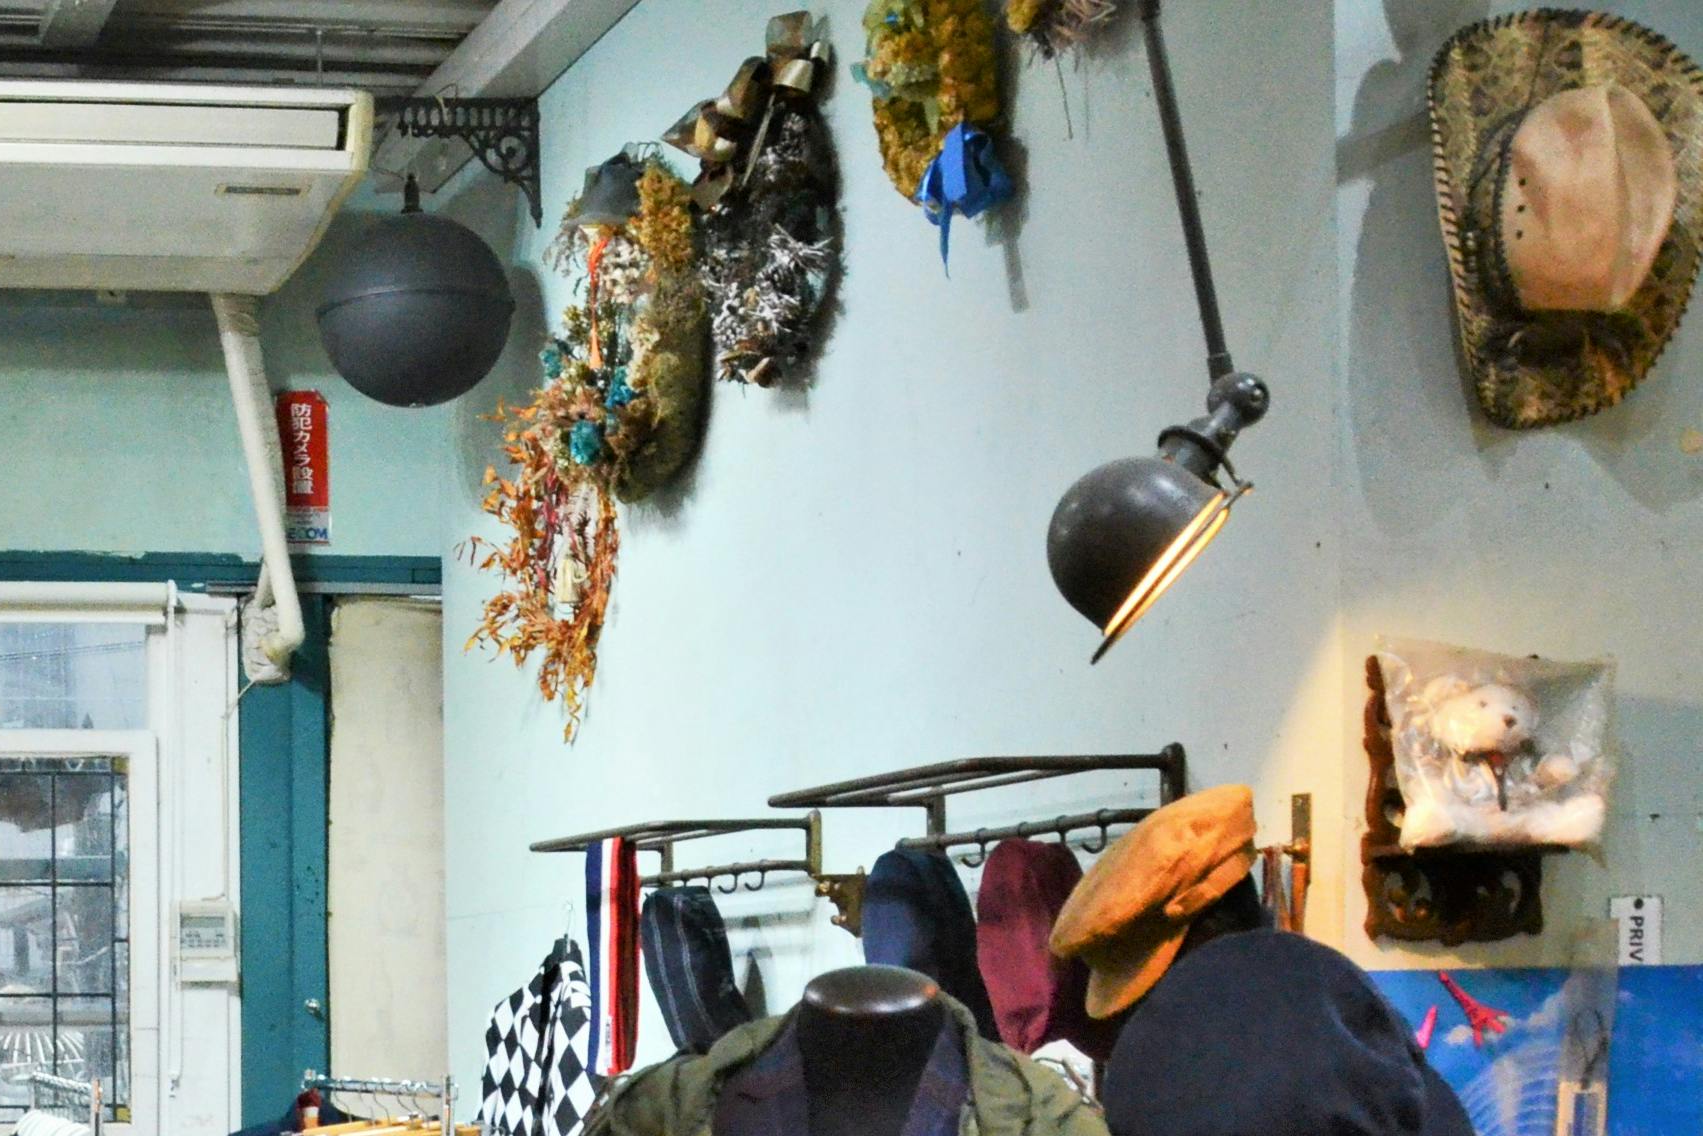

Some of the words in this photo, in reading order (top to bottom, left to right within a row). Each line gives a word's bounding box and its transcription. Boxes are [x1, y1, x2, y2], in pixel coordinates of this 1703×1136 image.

[290, 403, 315, 494] 防犯カメラ設置
[1629, 915, 1644, 962] PRIV
